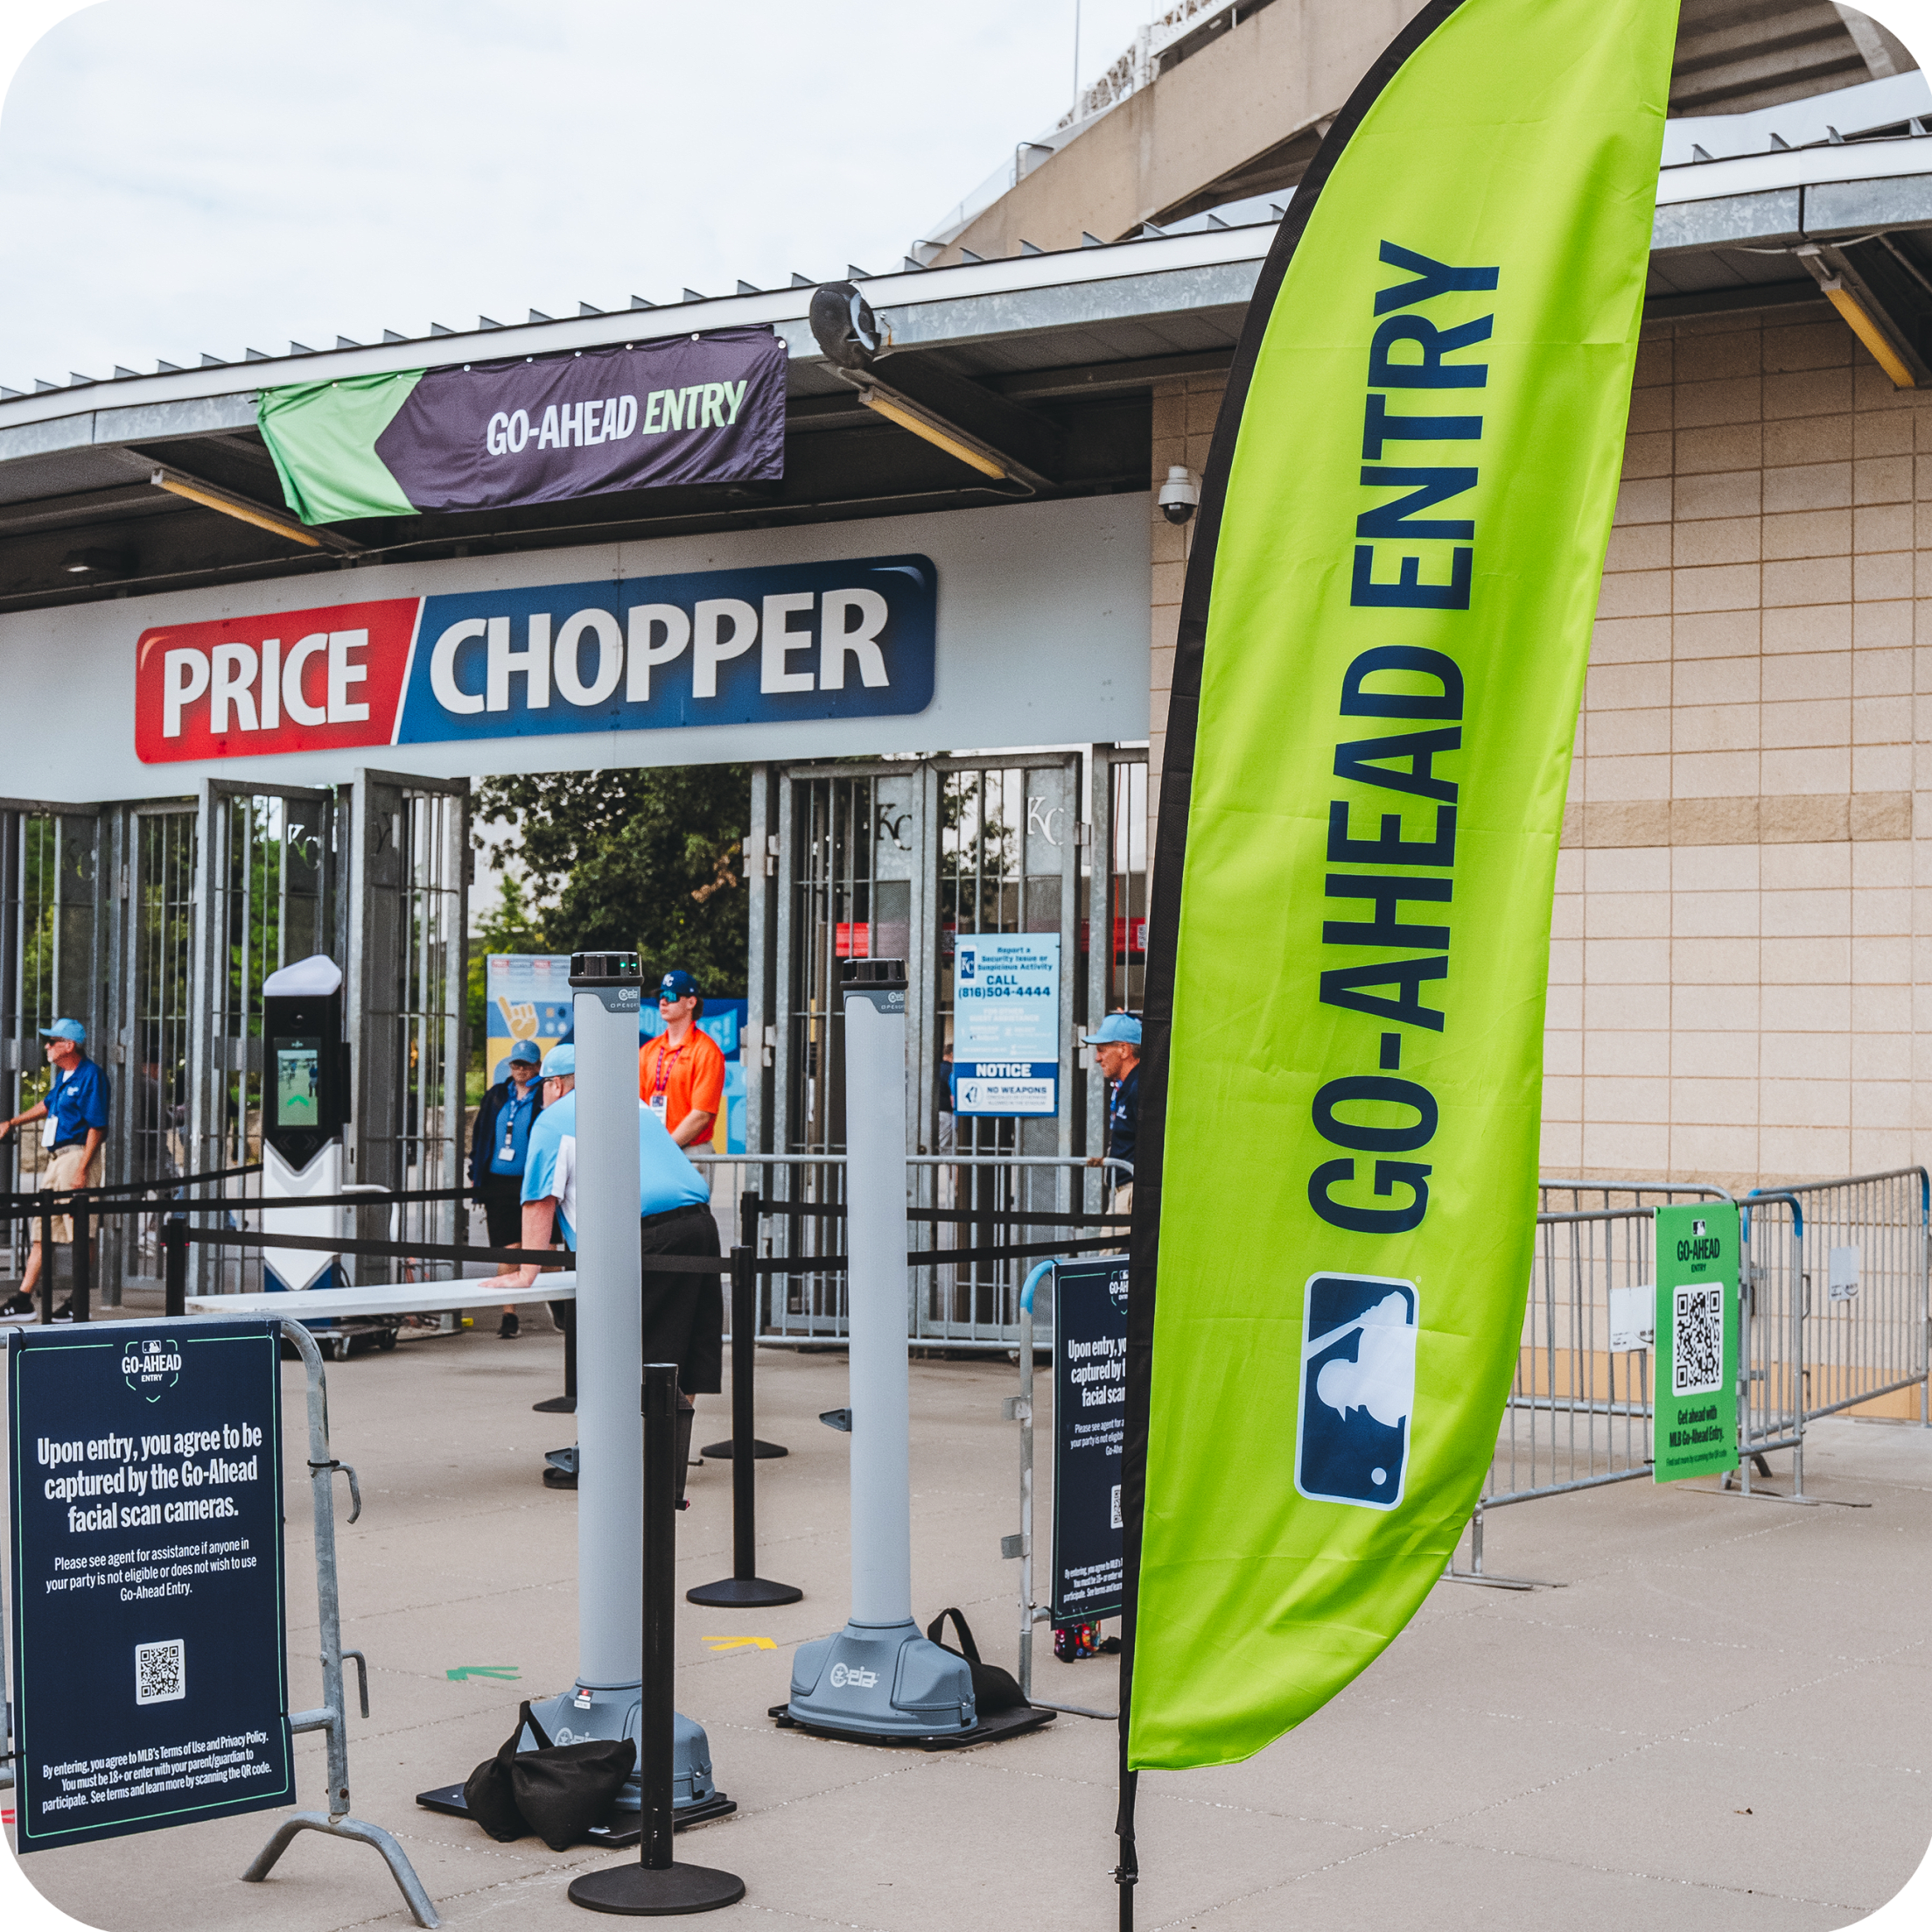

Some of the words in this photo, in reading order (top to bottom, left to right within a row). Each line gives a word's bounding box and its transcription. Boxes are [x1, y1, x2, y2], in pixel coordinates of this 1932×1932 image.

[487, 395, 637, 456] GO-AHEAD
[643, 381, 746, 434] ENTRY
[1350, 240, 1500, 610] ENTRY
[163, 628, 369, 738] PRICE
[430, 587, 890, 715] CHOPPER
[1308, 645, 1464, 1235] GO-AHEAD
[987, 976, 1018, 985] CALL
[976, 1064, 1032, 1077] NOTICE
[1677, 1238, 1720, 1262] GO-AHEAD
[1110, 1280, 1129, 1294] GO-AH
[122, 1354, 181, 1374] GO-AHEAD
[1068, 1340, 1090, 1362] Upon
[1092, 1336, 1116, 1357] entry,
[1071, 1360, 1110, 1386] captured
[1111, 1360, 1121, 1381] by
[1082, 1385, 1106, 1407] facial
[1070, 1438, 1081, 1449] your
[1082, 1436, 1095, 1447] party
[1096, 1435, 1099, 1444] is
[1074, 1424, 1091, 1433] Please
[1101, 1419, 1113, 1432] agent
[38, 1438, 83, 1469] Upon
[88, 1432, 137, 1463] entry,
[141, 1435, 171, 1461] you
[174, 1430, 220, 1457] agree
[223, 1424, 240, 1449] to
[242, 1422, 262, 1447] be
[45, 1467, 124, 1502] captured
[128, 1466, 148, 1495] by
[150, 1464, 178, 1489] the
[182, 1455, 257, 1487] Go-Ahead
[68, 1502, 117, 1532] facial
[121, 1503, 161, 1527] scan
[164, 1497, 239, 1522] cameras.
[55, 1558, 87, 1571] Please
[89, 1555, 106, 1567] see
[108, 1550, 135, 1566] agent
[136, 1549, 150, 1562] for
[151, 1544, 200, 1559] assistance
[201, 1542, 207, 1555] if
[209, 1539, 239, 1556] anyone
[241, 1537, 248, 1550] in
[46, 1578, 68, 1593] your
[70, 1573, 95, 1591] party
[98, 1572, 105, 1585] is
[108, 1570, 122, 1584] not
[125, 1566, 158, 1583] eligible
[160, 1567, 169, 1578] or
[172, 1563, 192, 1577] does
[194, 1560, 208, 1574] not
[211, 1558, 229, 1572] wish
[232, 1558, 240, 1569] to
[242, 1556, 256, 1568] use
[121, 1585, 164, 1600] Go-Ahead
[167, 1582, 192, 1595] Entry.
[43, 1765, 52, 1780] By
[54, 1760, 89, 1776] entering,
[91, 1759, 104, 1773] you
[106, 1755, 128, 1769] agree
[129, 1752, 136, 1764] to
[137, 1747, 159, 1762] MLB's
[160, 1746, 182, 1759] Terms
[184, 1742, 192, 1755] of
[192, 1741, 206, 1754] Use
[206, 1737, 220, 1751] and
[220, 1735, 245, 1748] Privacy
[246, 1731, 269, 1744] Policy.
[62, 1779, 75, 1791] You
[77, 1774, 97, 1788] must
[98, 1774, 108, 1785] be
[109, 1770, 122, 1783] 18+
[124, 1771, 132, 1782] or
[134, 1766, 153, 1780] enter
[155, 1762, 170, 1777] with
[172, 1760, 187, 1775] your
[188, 1750, 245, 1773] parent/guardian
[246, 1748, 254, 1760] to
[43, 1793, 88, 1814] participate.
[91, 1790, 105, 1803] See
[107, 1788, 130, 1801] terms
[130, 1782, 144, 1796] and
[145, 1780, 164, 1794] learn
[165, 1778, 185, 1790] more
[186, 1775, 194, 1788] by
[195, 1769, 228, 1785] scanning
[228, 1768, 240, 1780] the
[242, 1764, 251, 1778] QR
[252, 1761, 272, 1775] code.
